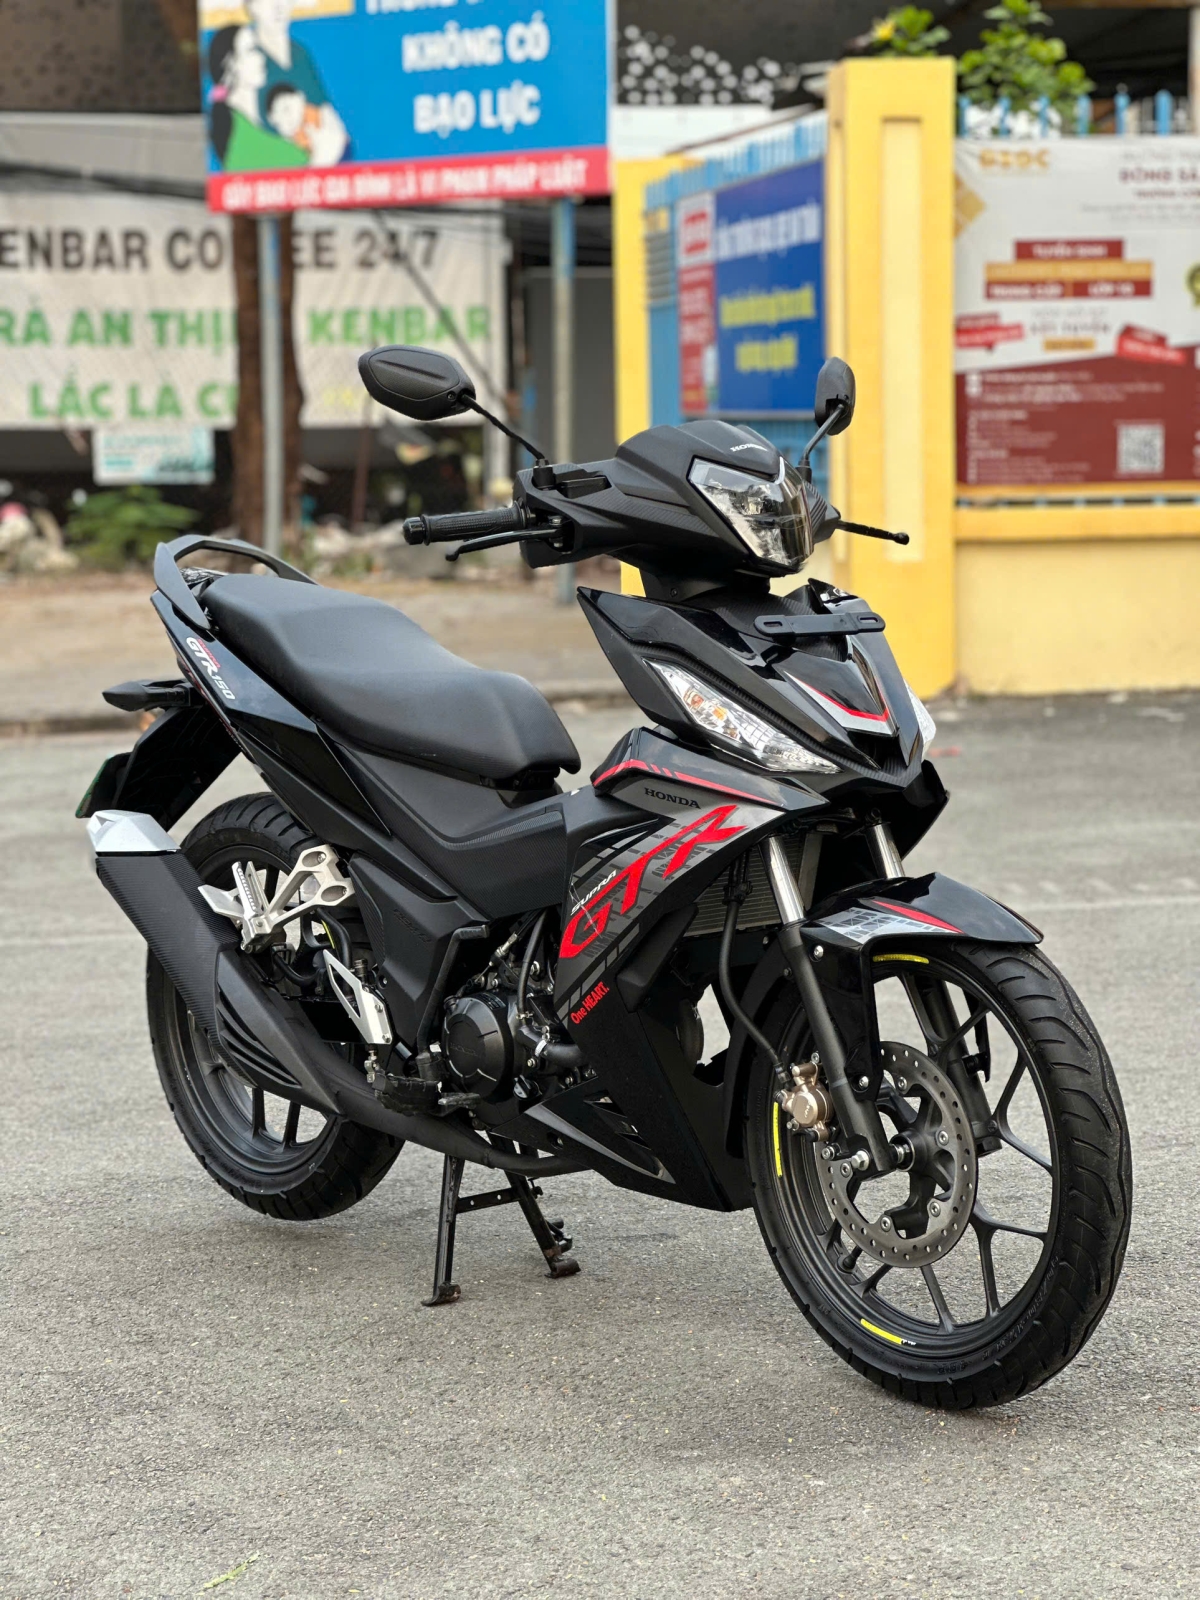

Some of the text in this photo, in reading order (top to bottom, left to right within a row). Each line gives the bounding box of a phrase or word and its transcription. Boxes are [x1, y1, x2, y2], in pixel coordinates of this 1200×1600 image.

[402, 10, 550, 73] KHÔNG CÓ
[413, 79, 541, 139] BẠO LỰC
[67, 307, 132, 346] AN
[309, 304, 490, 345] KENBAR
[186, 636, 236, 700] GTR 150
[644, 786, 702, 810] HONDA
[559, 804, 748, 959] GTR
[570, 869, 617, 916] SUPRA
[570, 1006, 588, 1025] One
